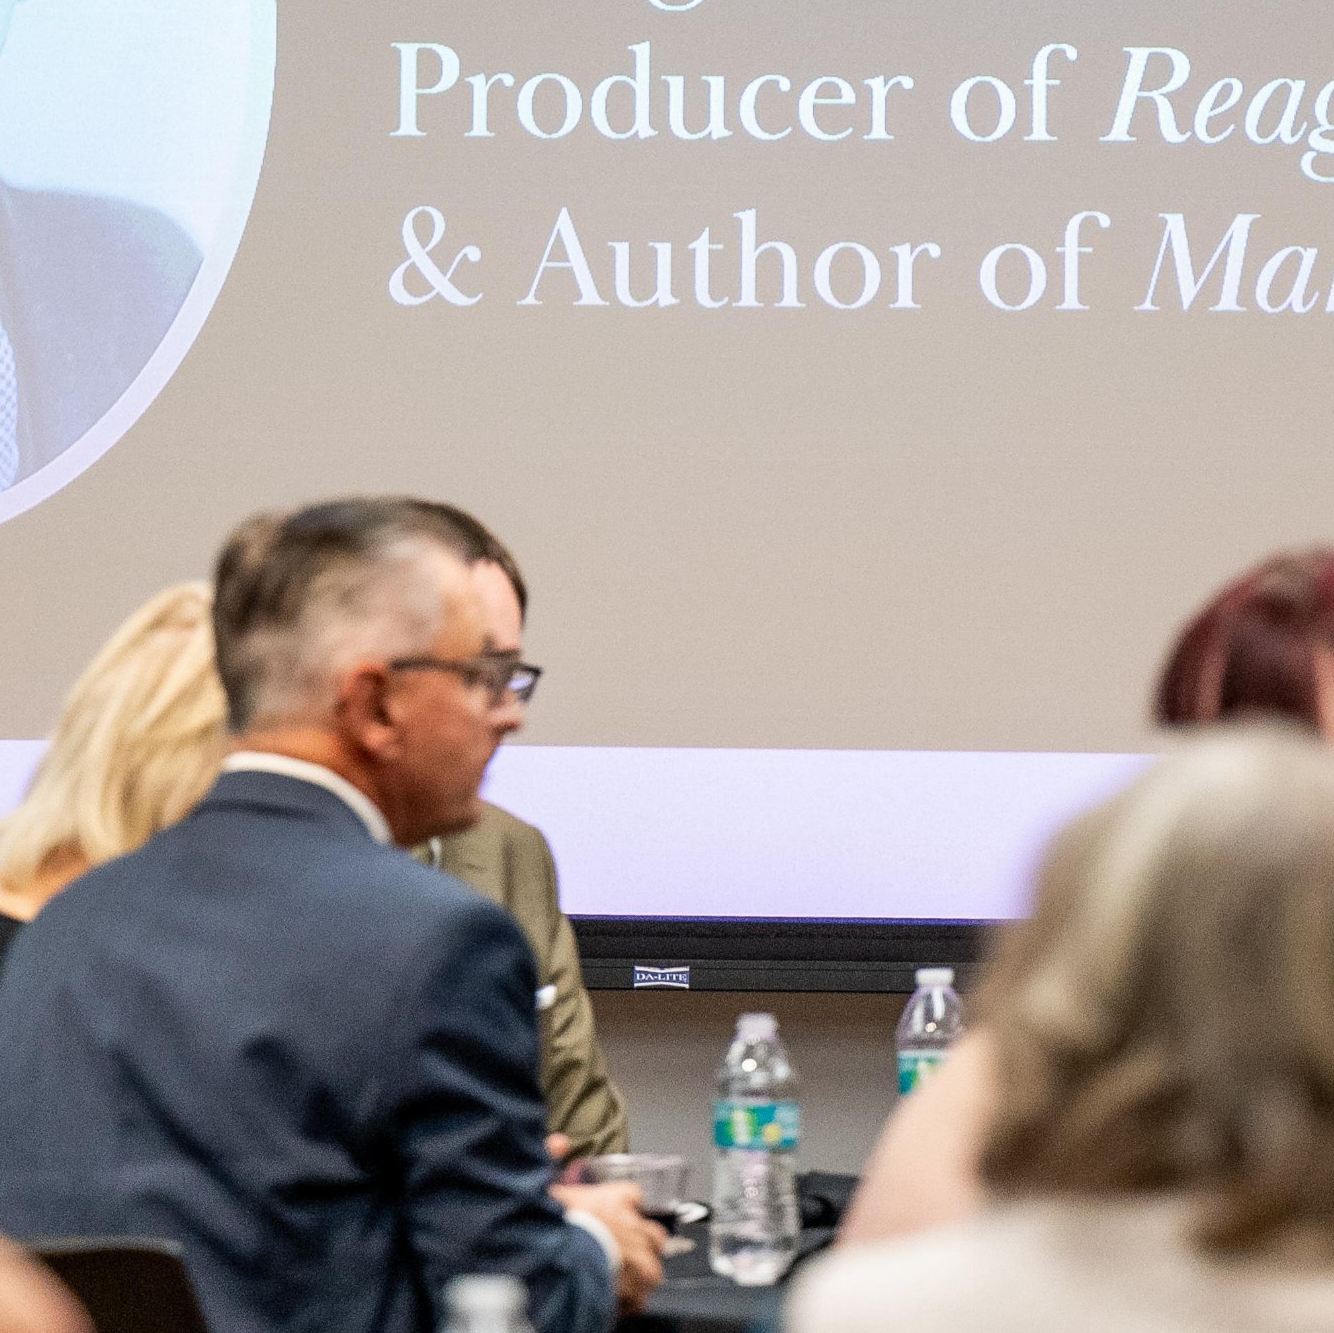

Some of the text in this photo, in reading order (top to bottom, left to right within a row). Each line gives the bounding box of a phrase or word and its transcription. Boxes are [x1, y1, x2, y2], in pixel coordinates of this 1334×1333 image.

[390, 41, 914, 141] Producer
[950, 43, 1078, 142] of
[388, 206, 482, 306] &
[519, 207, 941, 309] Author
[979, 210, 1111, 311] of
[636, 973, 687, 982] DA-LITE
